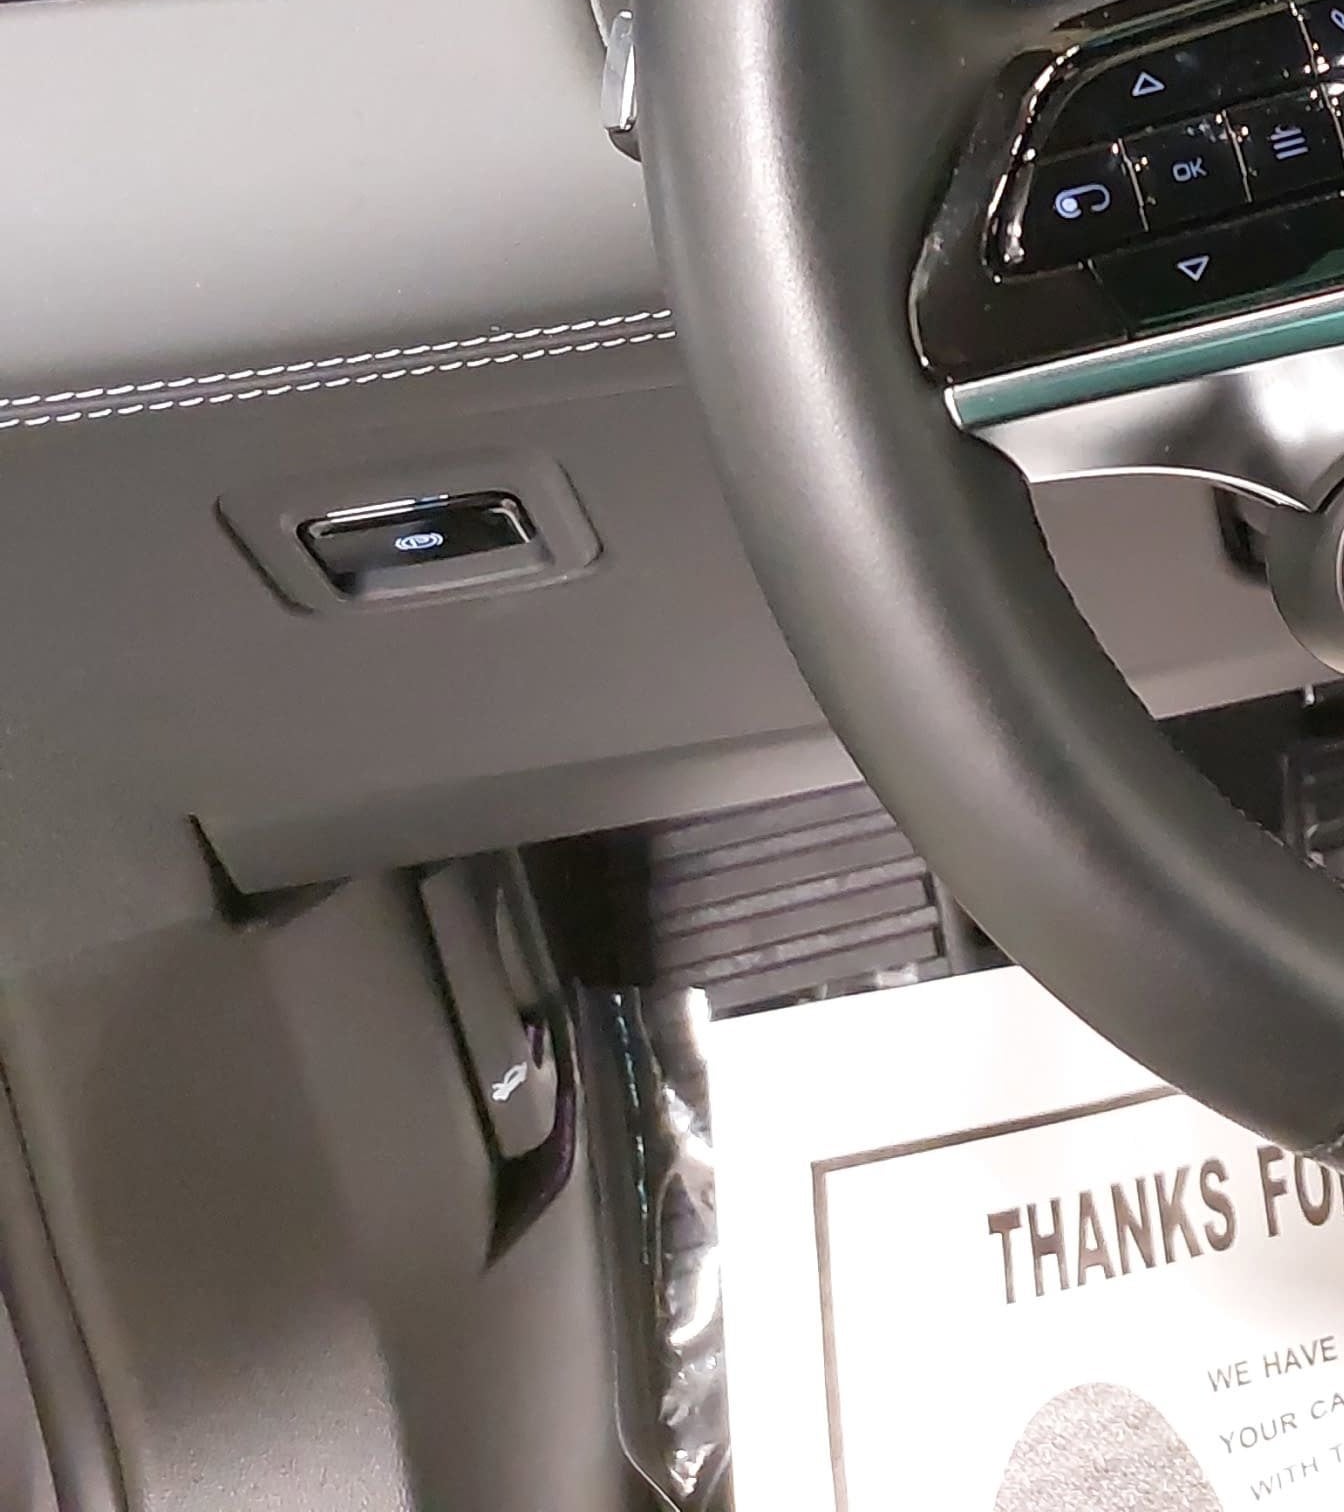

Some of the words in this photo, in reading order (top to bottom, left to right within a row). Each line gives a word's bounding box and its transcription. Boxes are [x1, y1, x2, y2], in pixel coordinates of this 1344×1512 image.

[1172, 158, 1208, 183] OK
[987, 1157, 1237, 1305] THANKS
[1207, 1360, 1252, 1393] WE
[1263, 1335, 1338, 1378] HAVE
[1219, 1412, 1299, 1455] YOUR
[1250, 1457, 1319, 1501] WITH
